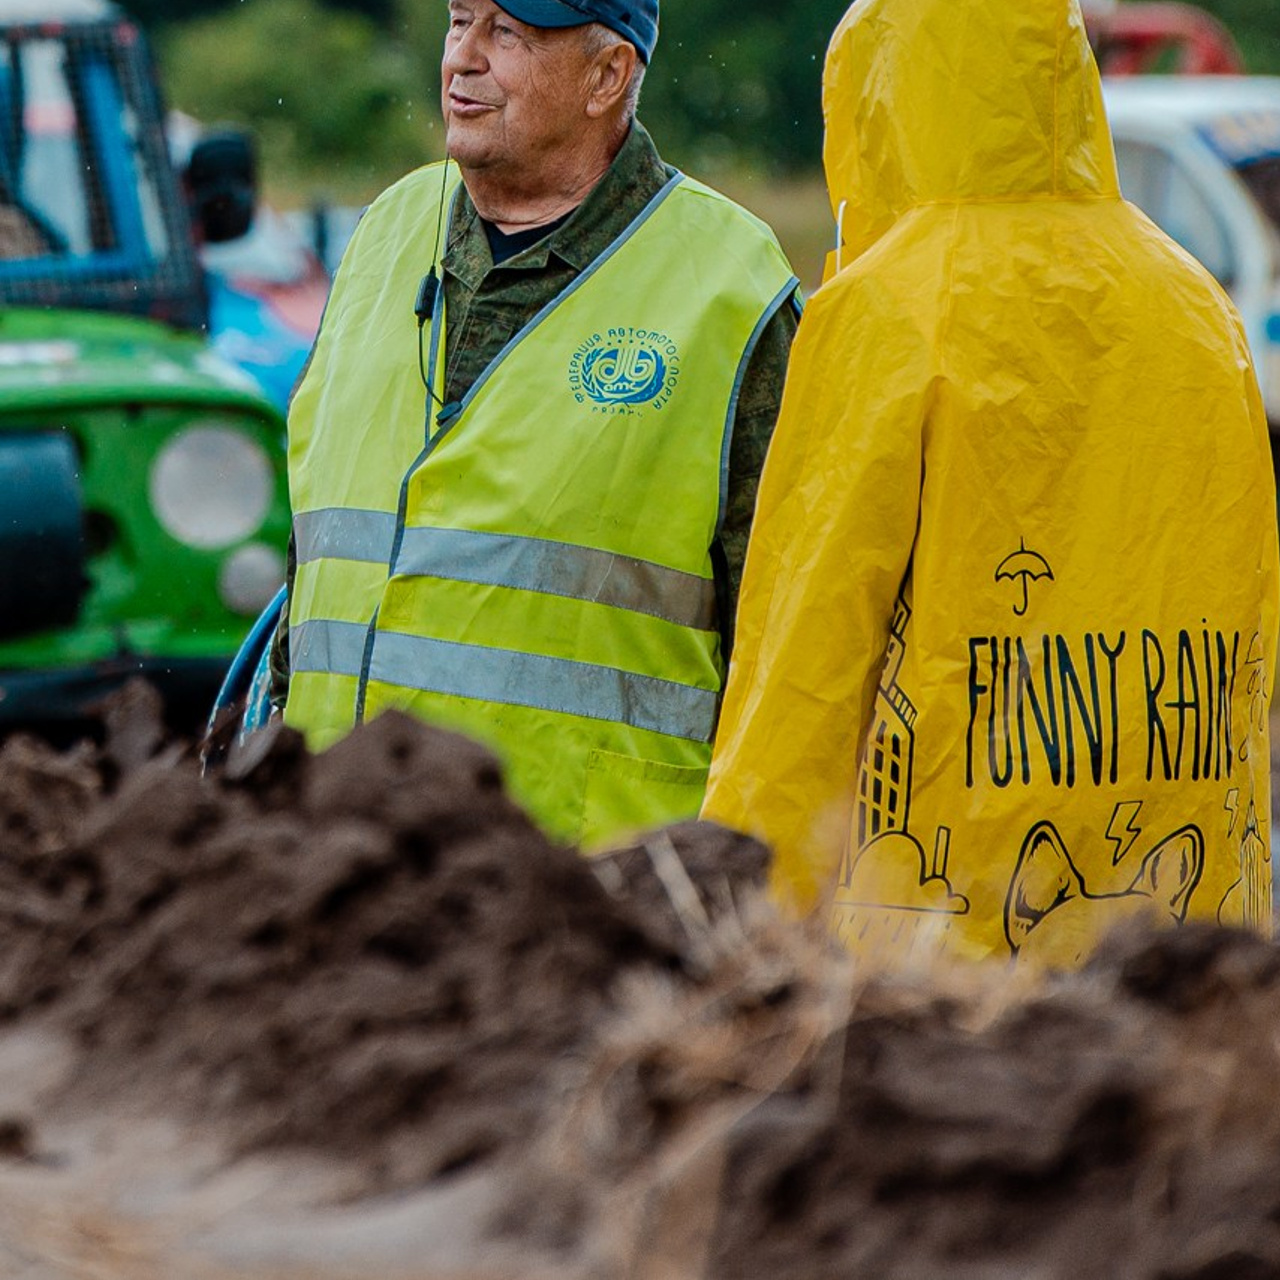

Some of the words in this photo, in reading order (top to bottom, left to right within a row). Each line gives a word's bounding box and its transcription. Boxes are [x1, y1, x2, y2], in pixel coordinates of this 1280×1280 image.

[568, 333, 602, 404] ФЕДЕРАЦИЯ
[608, 327, 680, 410] АВТОМОТОСПОРТА
[965, 629, 1126, 789] FUNNY
